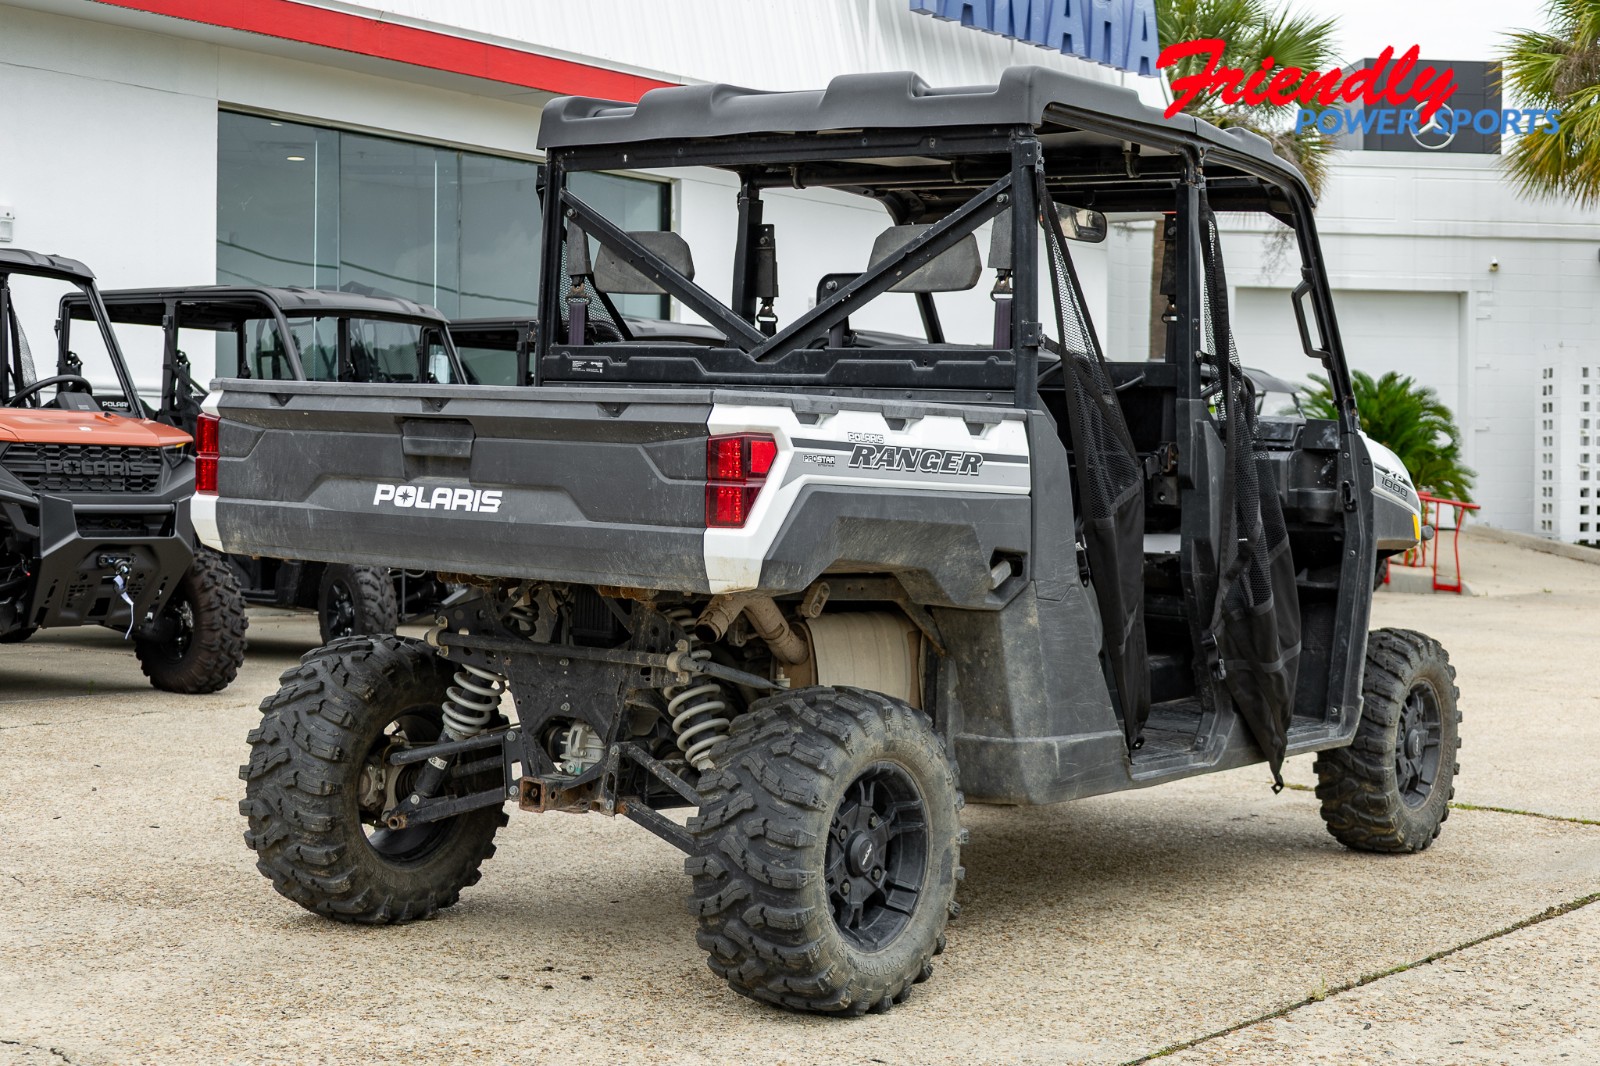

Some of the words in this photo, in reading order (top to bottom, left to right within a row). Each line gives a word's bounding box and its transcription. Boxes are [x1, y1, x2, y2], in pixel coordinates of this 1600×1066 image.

[847, 432, 884, 444] POLARIS
[45, 459, 144, 476] POLARIS
[803, 454, 835, 464] PROSTAR
[848, 444, 983, 476] RANGER
[1382, 477, 1408, 497] 1000
[373, 483, 503, 513] POLARIS
